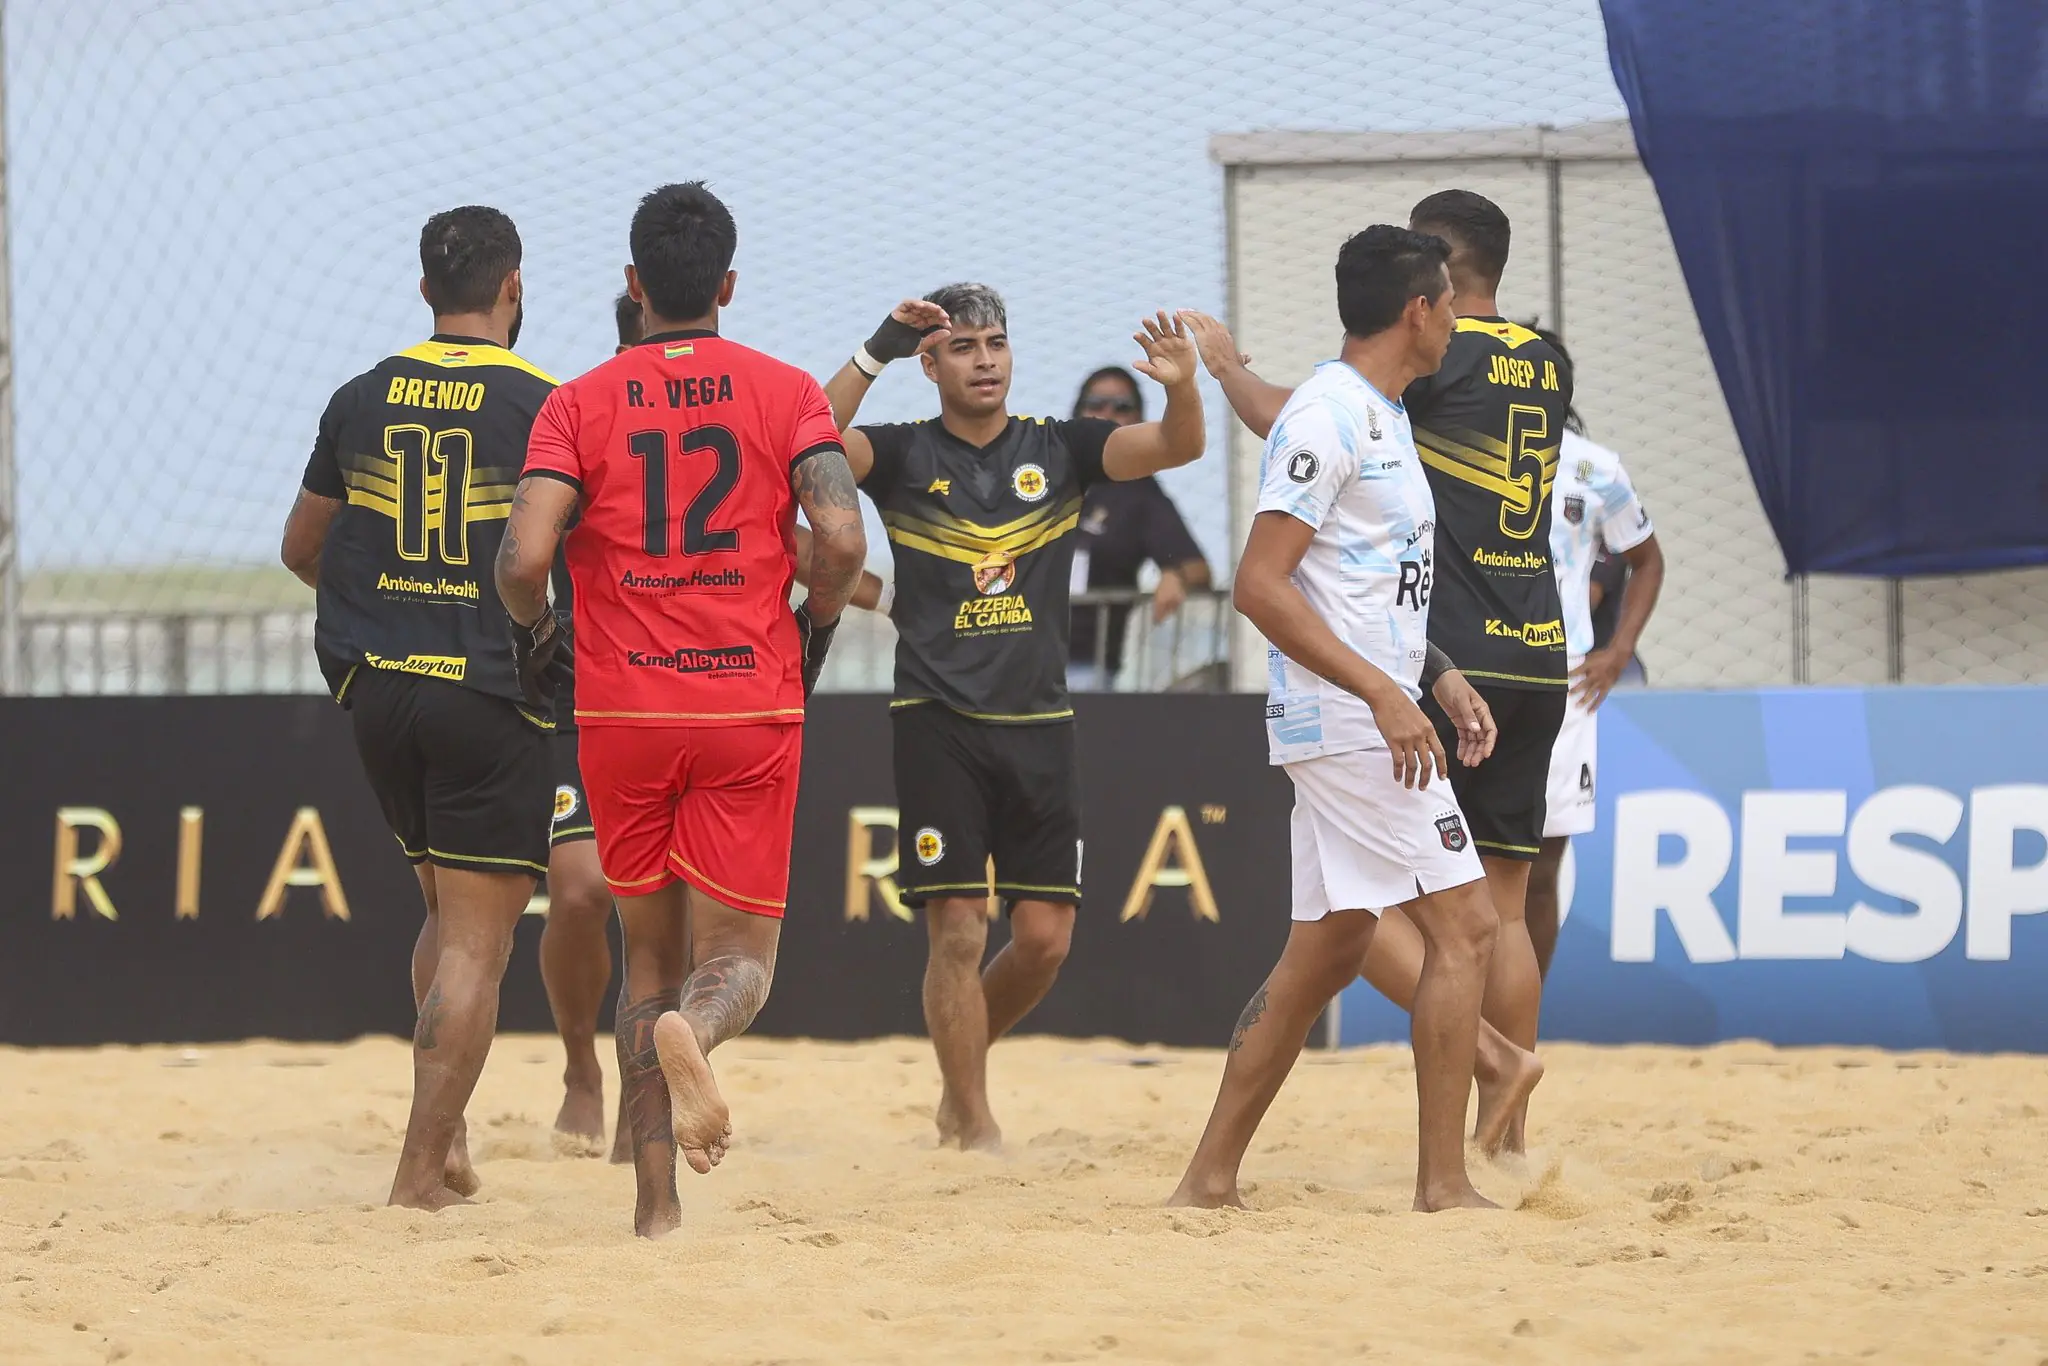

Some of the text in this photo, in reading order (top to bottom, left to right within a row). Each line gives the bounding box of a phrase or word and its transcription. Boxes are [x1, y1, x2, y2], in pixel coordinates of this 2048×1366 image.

[1487, 355, 1535, 389] JOSEP
[386, 377, 486, 411] BRENDO
[626, 375, 734, 409] R. VEGA
[1500, 404, 1547, 539] 5
[384, 424, 472, 565] 11
[627, 423, 743, 558] 12
[954, 608, 1033, 630] EL CAMBA
[960, 594, 1026, 615] PIZZERIA
[1610, 784, 2048, 964] RESP
